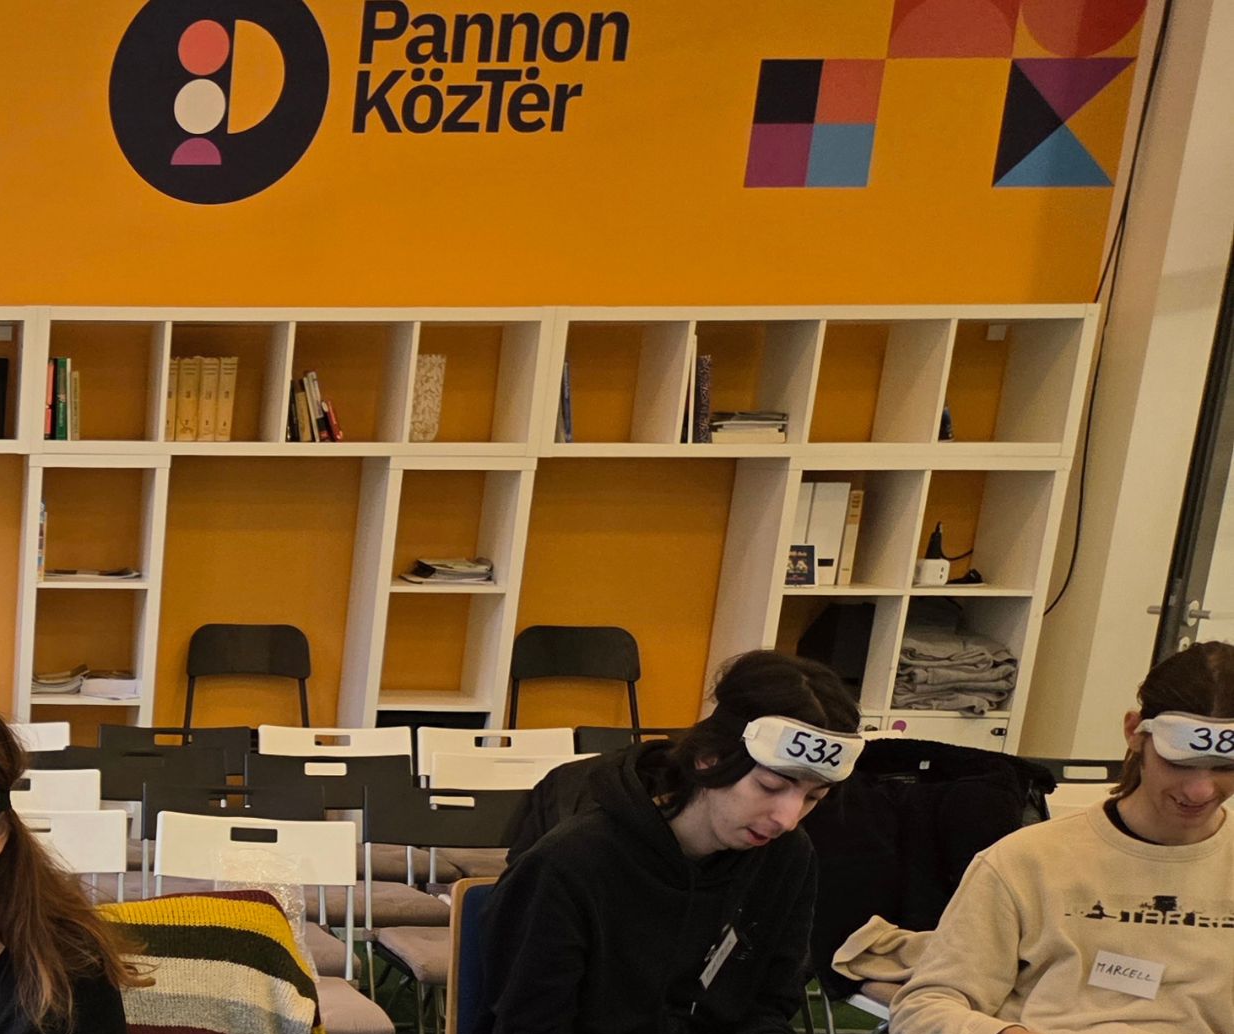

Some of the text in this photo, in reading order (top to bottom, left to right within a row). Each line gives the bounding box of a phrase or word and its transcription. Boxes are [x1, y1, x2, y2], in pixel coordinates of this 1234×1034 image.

[359, 0, 630, 64] Pannon
[786, 731, 843, 767] 532
[1095, 961, 1158, 982] MARCELL
